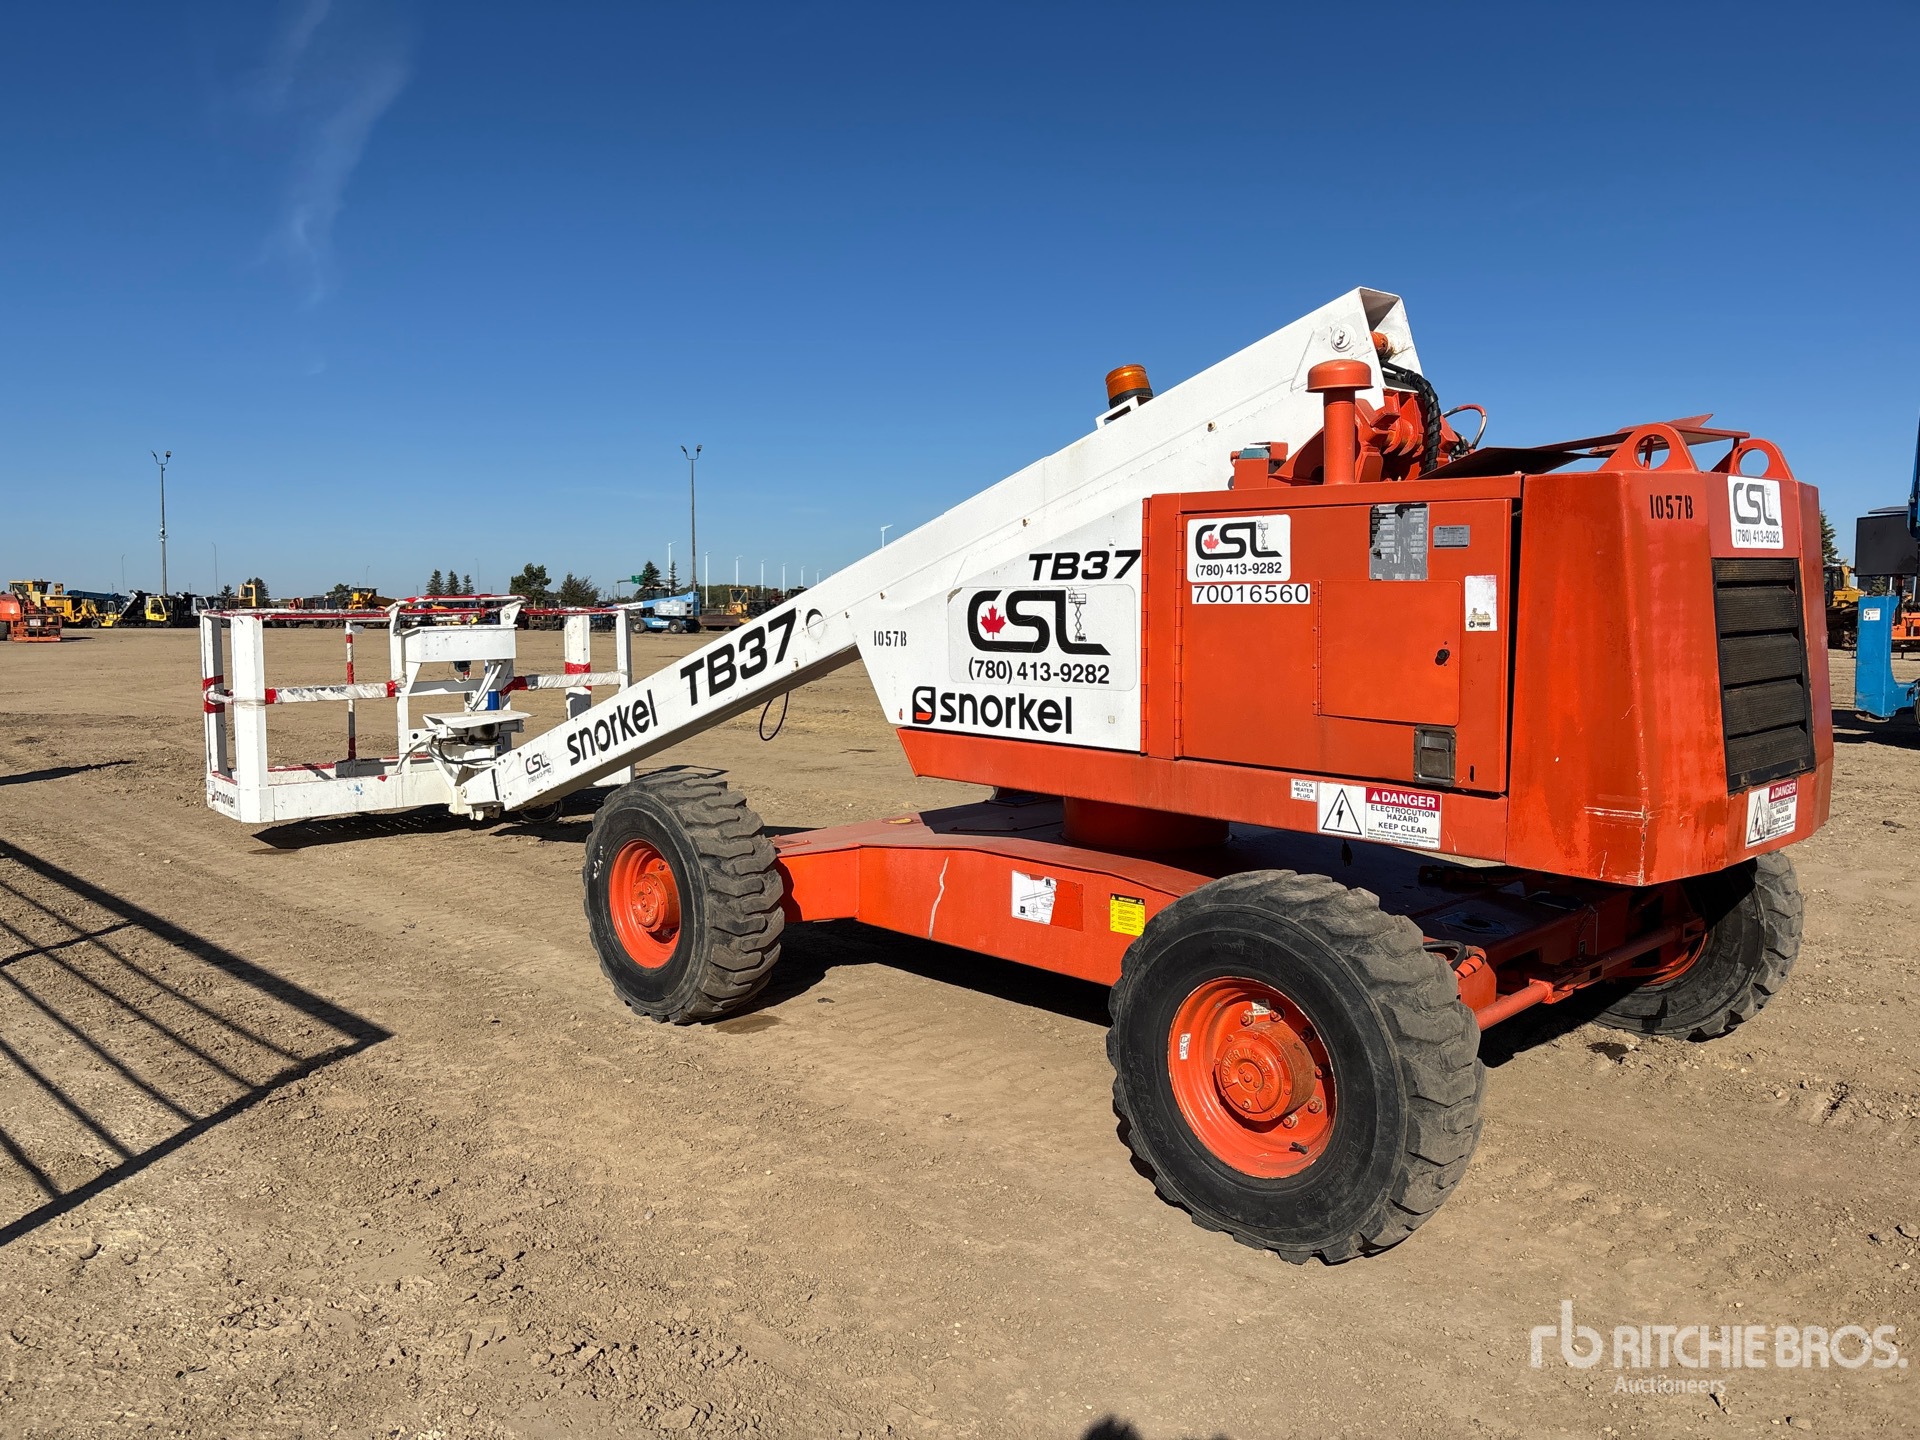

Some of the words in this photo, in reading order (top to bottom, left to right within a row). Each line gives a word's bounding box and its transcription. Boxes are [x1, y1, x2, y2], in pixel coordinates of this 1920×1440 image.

[1733, 482, 1779, 526] CSL
[1194, 521, 1283, 561] CSL
[1735, 528, 1752, 545] (780)
[1752, 529, 1780, 544] 413-9282
[1028, 549, 1142, 581] TB37
[1195, 562, 1225, 578] (780)
[1225, 561, 1283, 576] 413-9282
[1193, 583, 1310, 603] 70016560
[967, 589, 1112, 656] CSL
[680, 607, 797, 707] TB37
[968, 657, 1013, 683] (780)
[1016, 661, 1111, 685] 413-9282
[940, 691, 1073, 735] snorkel
[566, 689, 659, 766] snorkel
[525, 752, 551, 776] CSL
[1293, 786, 1314, 794] HEATER
[1381, 791, 1436, 808] DANGER
[1775, 783, 1796, 798] DANGER
[1370, 804, 1436, 819] ELECTROCUTION
[1386, 813, 1419, 824] HAZARD
[1378, 821, 1399, 830] KEEP
[1400, 824, 1428, 834] CLEAR
